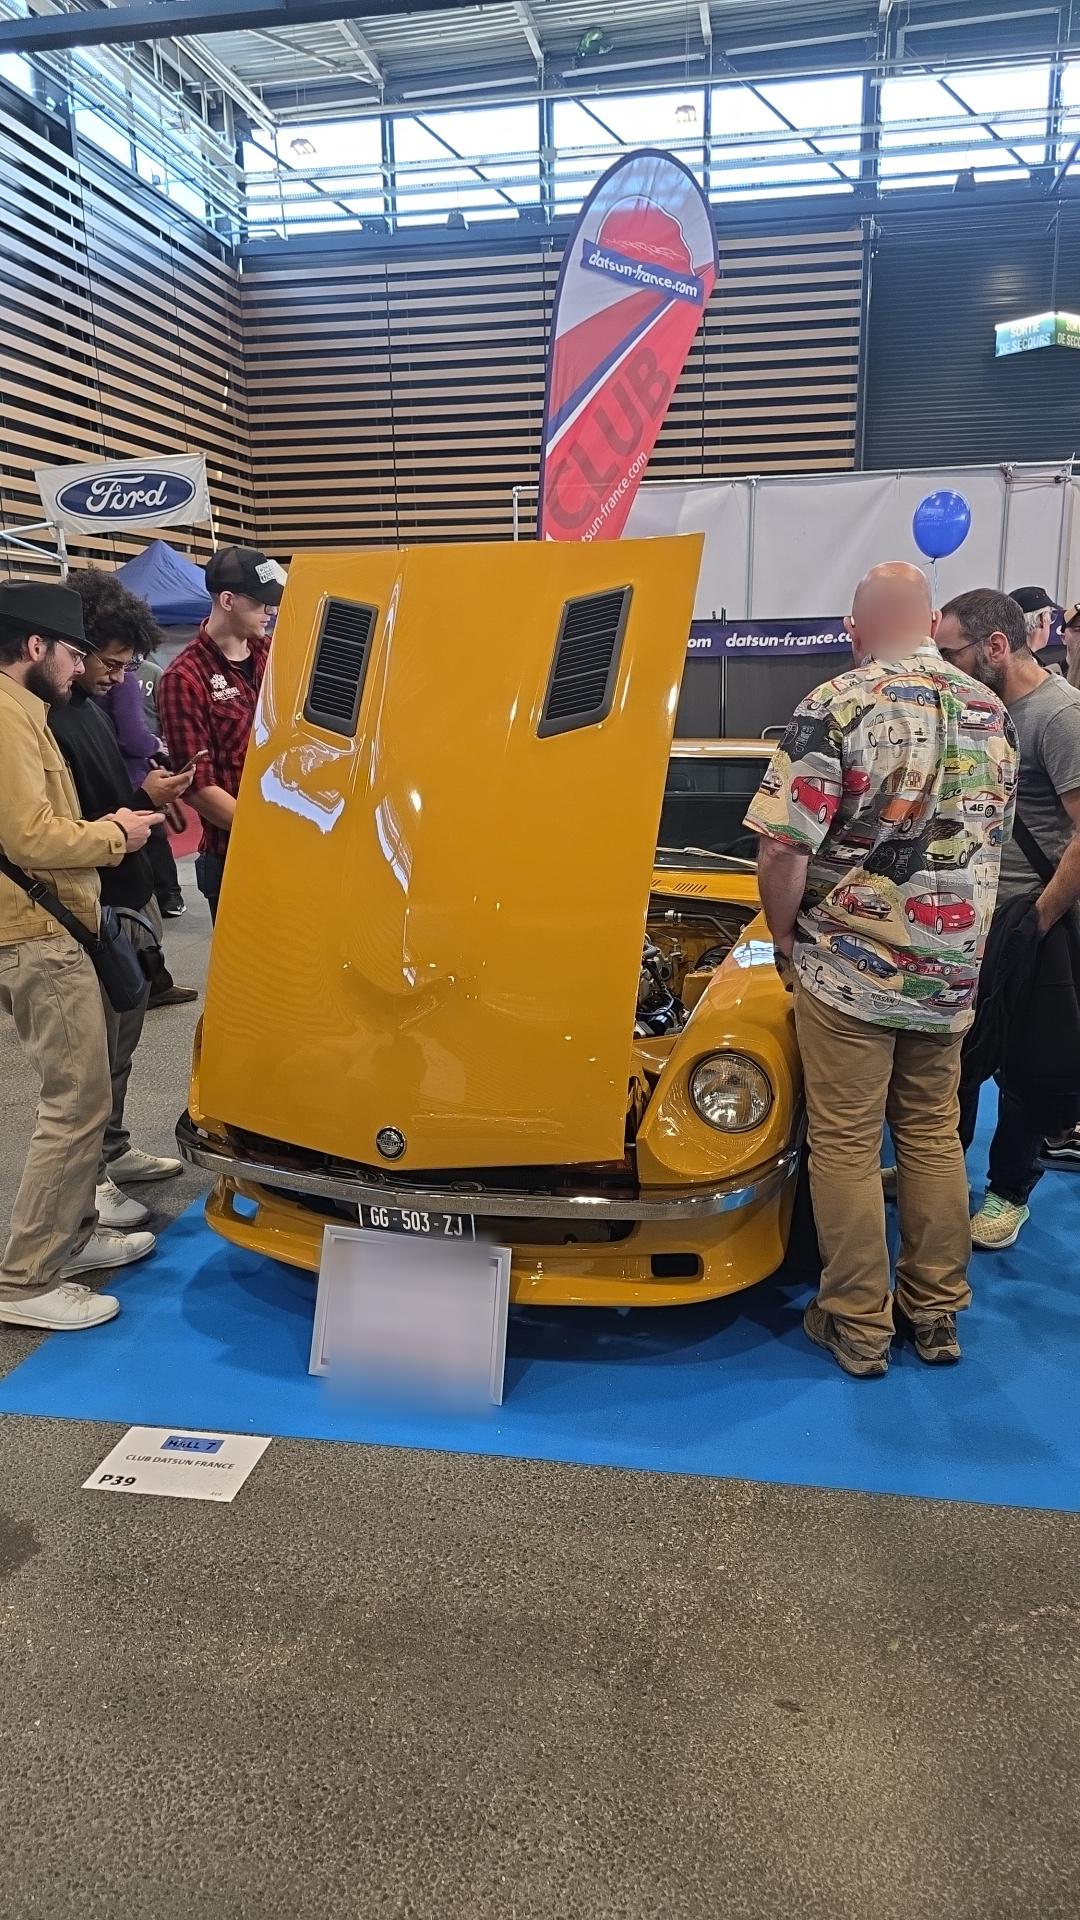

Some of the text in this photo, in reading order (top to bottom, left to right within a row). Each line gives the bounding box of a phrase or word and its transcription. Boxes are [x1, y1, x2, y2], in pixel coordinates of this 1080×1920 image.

[588, 250, 698, 298] datsun-france.com
[1010, 323, 1041, 338] SORTIE
[1057, 333, 1066, 344] DE
[1000, 333, 1051, 353] DE SECOURS
[545, 346, 671, 530] CLUB
[86, 475, 168, 513] Ford
[580, 451, 649, 542] tsun-france.com
[725, 631, 853, 648] datsun-france.co
[969, 803, 984, 812] 46
[871, 992, 896, 1004] NISSAN
[167, 1439, 217, 1451] HALL 7
[125, 1454, 236, 1470] CLUB DATSUN FRANCE
[98, 1474, 137, 1487] P39
